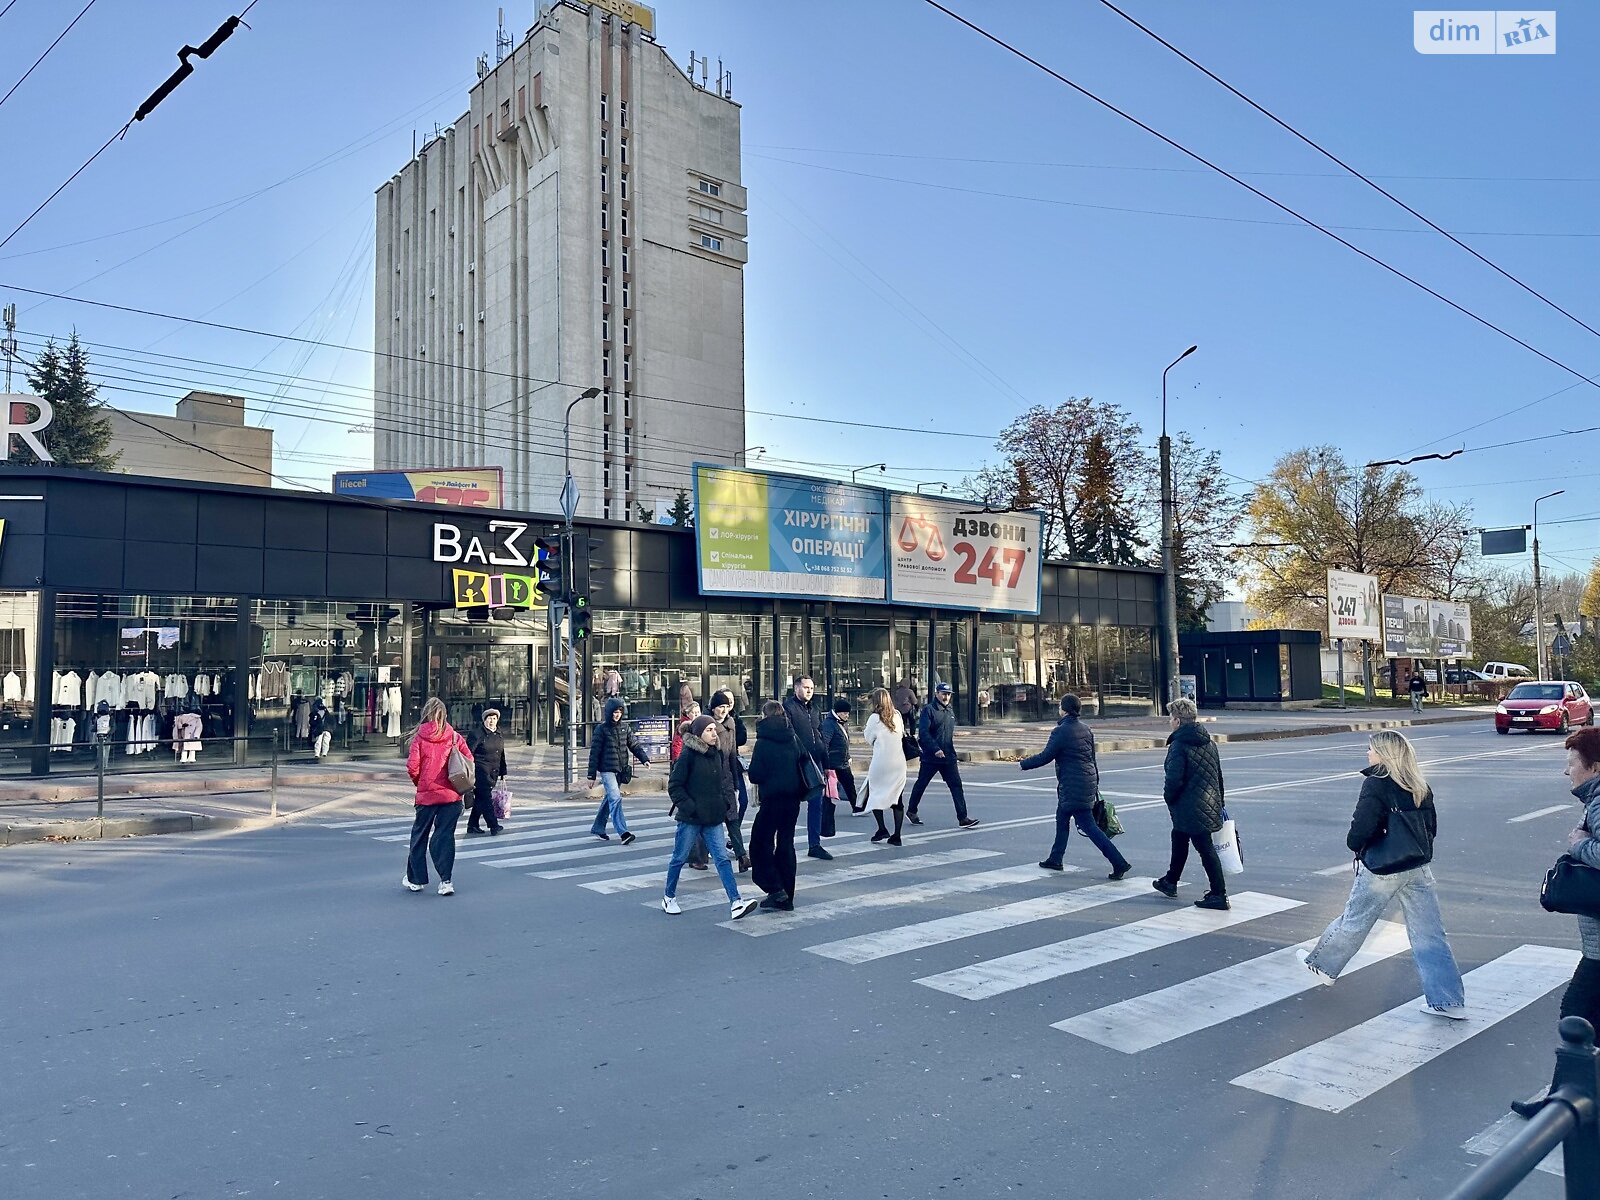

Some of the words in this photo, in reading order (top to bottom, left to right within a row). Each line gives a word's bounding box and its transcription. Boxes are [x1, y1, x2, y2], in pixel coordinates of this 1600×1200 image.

[340, 478, 367, 489] lifecell
[783, 509, 870, 533] ХІРУРГІЧНІ
[952, 517, 1026, 542] ДЗВОНИ
[720, 531, 759, 541] ЛОР-хірургія
[791, 537, 865, 562] ОПЕРАЦІЇ
[721, 551, 753, 561] Спінальна
[721, 562, 747, 571] хірургія
[577, 597, 586, 608] 6
[1337, 595, 1357, 616] 247
